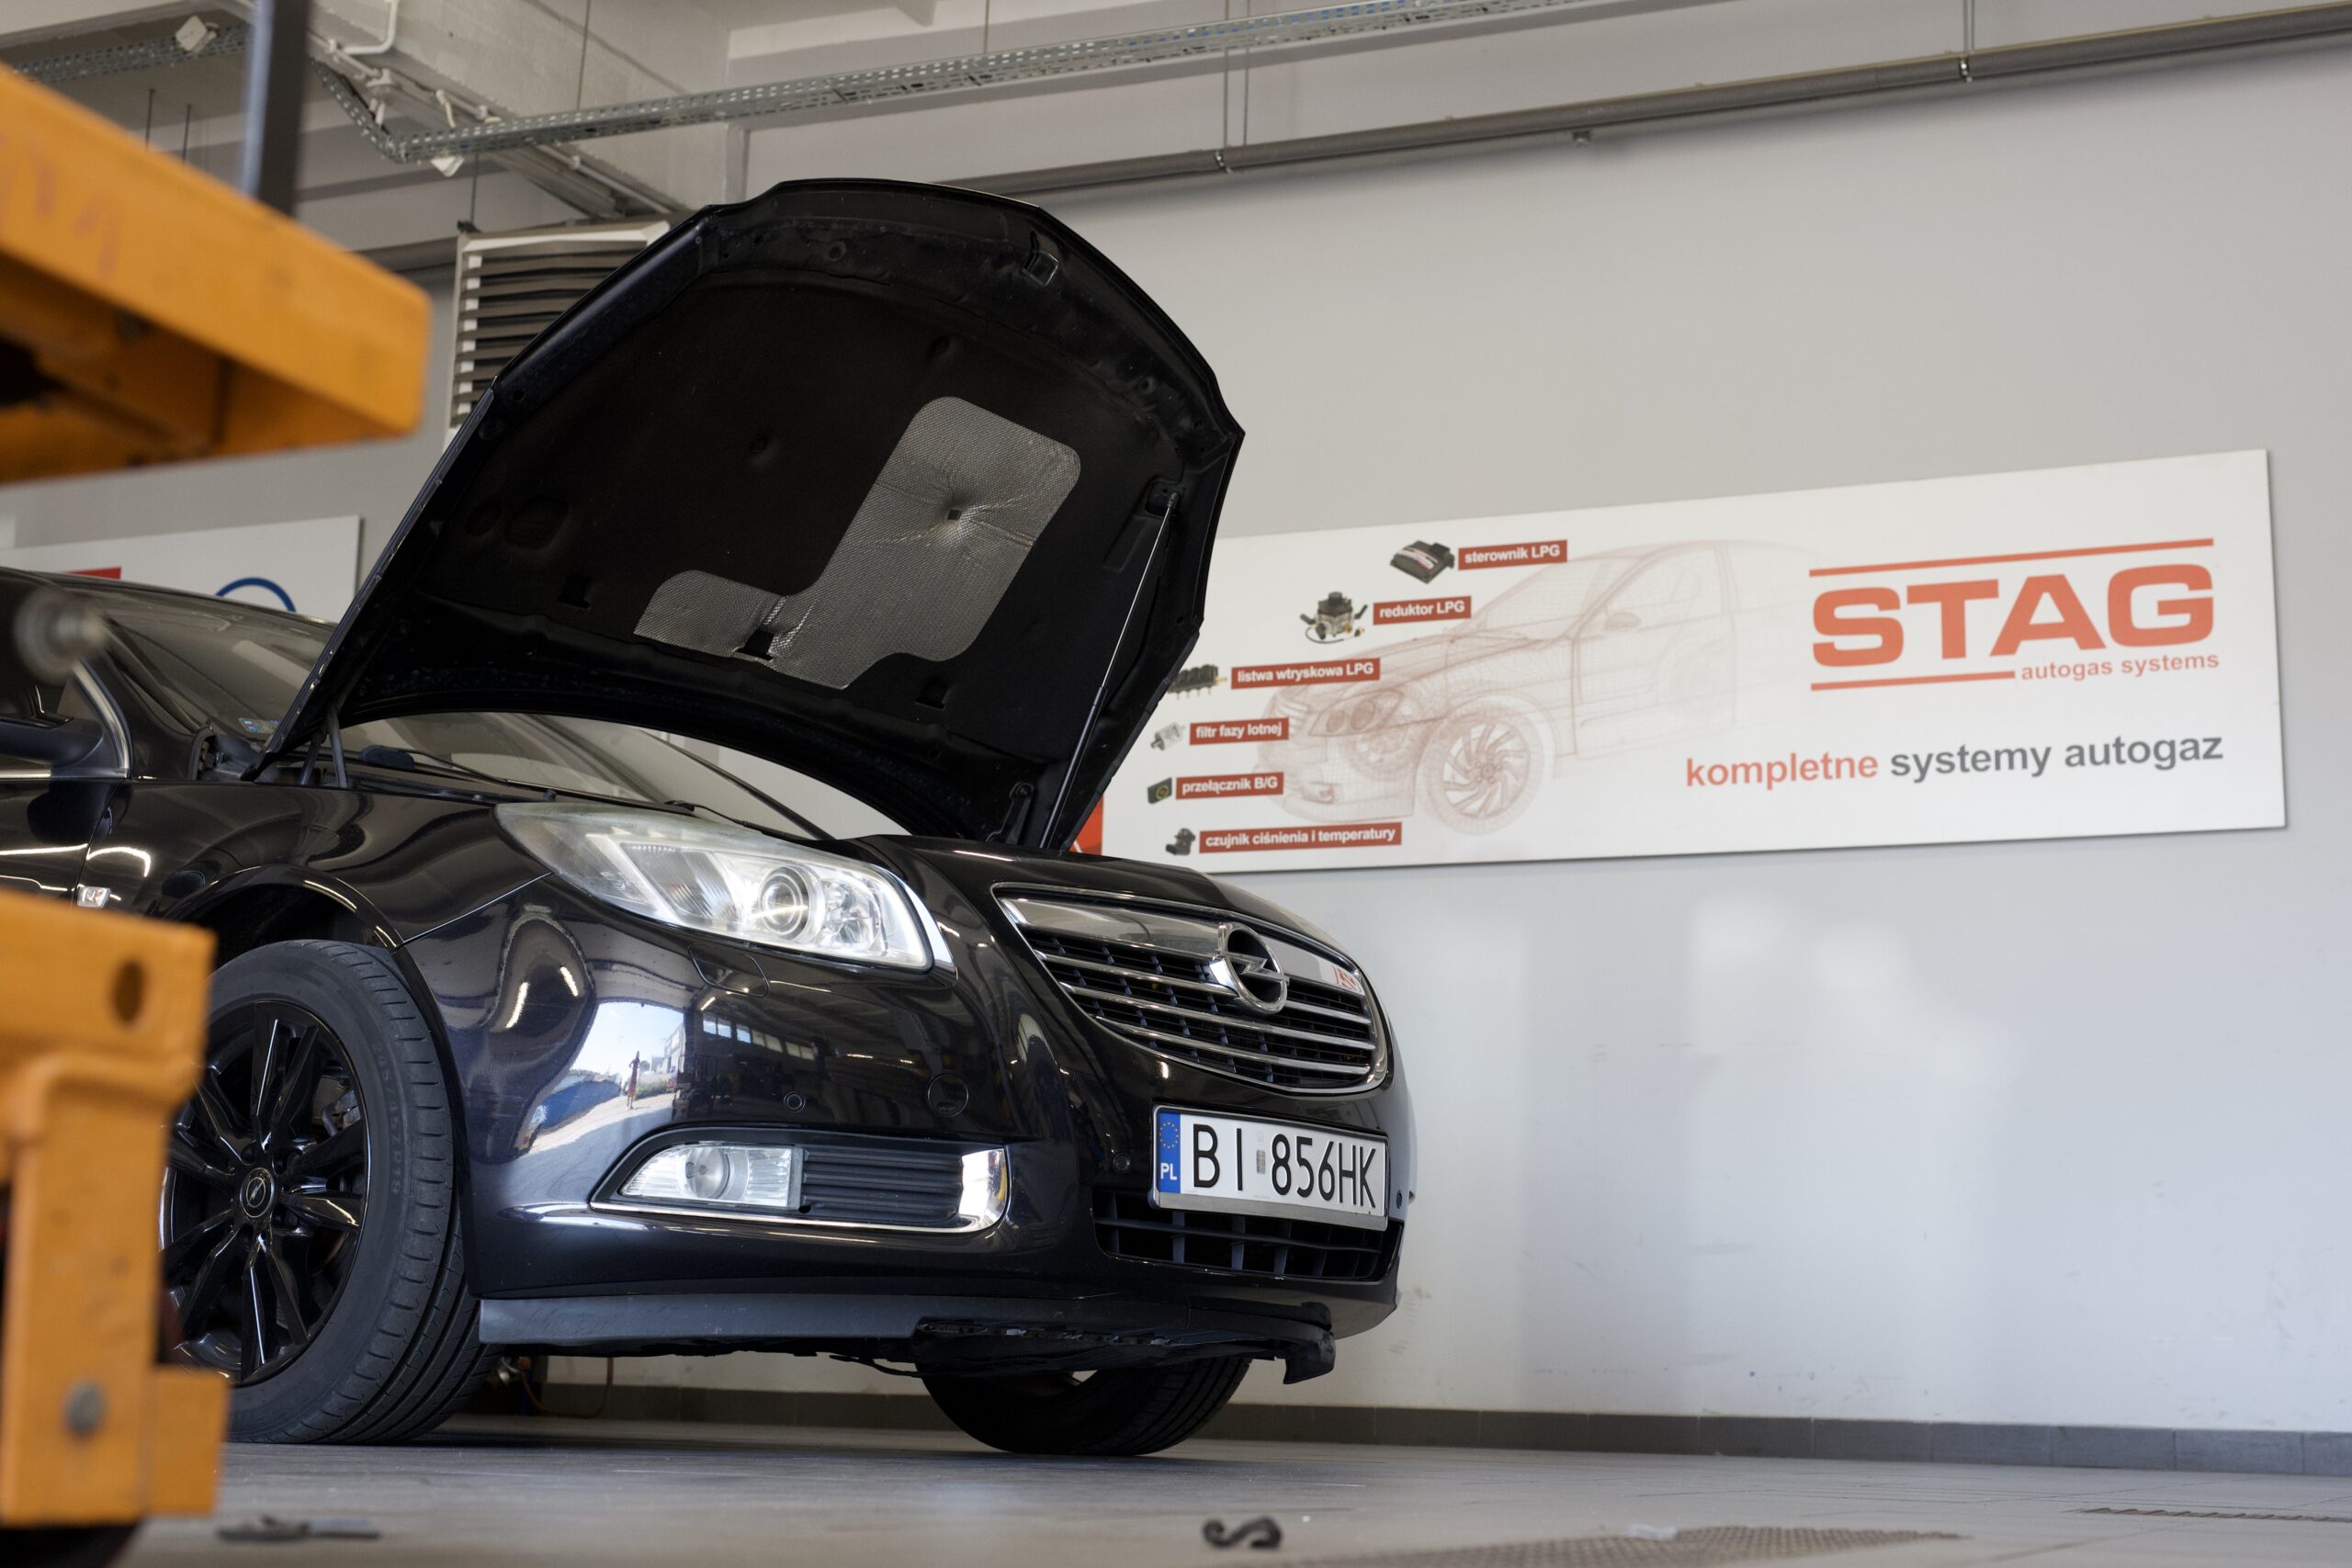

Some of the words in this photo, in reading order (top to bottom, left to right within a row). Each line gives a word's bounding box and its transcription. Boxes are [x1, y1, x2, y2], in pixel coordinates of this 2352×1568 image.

[1464, 547, 1530, 564] sterownik
[1531, 544, 1561, 559] LPG
[1379, 603, 1435, 618] reduktor
[1436, 600, 1466, 615] LPG
[1813, 563, 2214, 668] STAG
[1237, 667, 1274, 682] listwa
[1275, 664, 1344, 683] wtryskowa
[1345, 661, 1374, 675] LPG
[2020, 659, 2113, 682] autogas
[2120, 654, 2220, 675] systems
[1195, 724, 1218, 739] filtr
[1218, 724, 1245, 740] fazy
[1247, 721, 1283, 739] lotnej
[1686, 752, 1879, 791] kompletne
[1890, 745, 2052, 784] systemy
[2064, 735, 2223, 771] autogaz
[1182, 778, 1252, 796] przełącznik
[1253, 775, 1279, 791] B/G
[1204, 833, 1250, 851] czujnik
[1251, 830, 1308, 846] ciśnienia
[1310, 831, 1317, 844] i
[1317, 827, 1396, 846] temperatury
[1160, 1162, 1178, 1180] PL
[1272, 1134, 1376, 1209] 856HK
